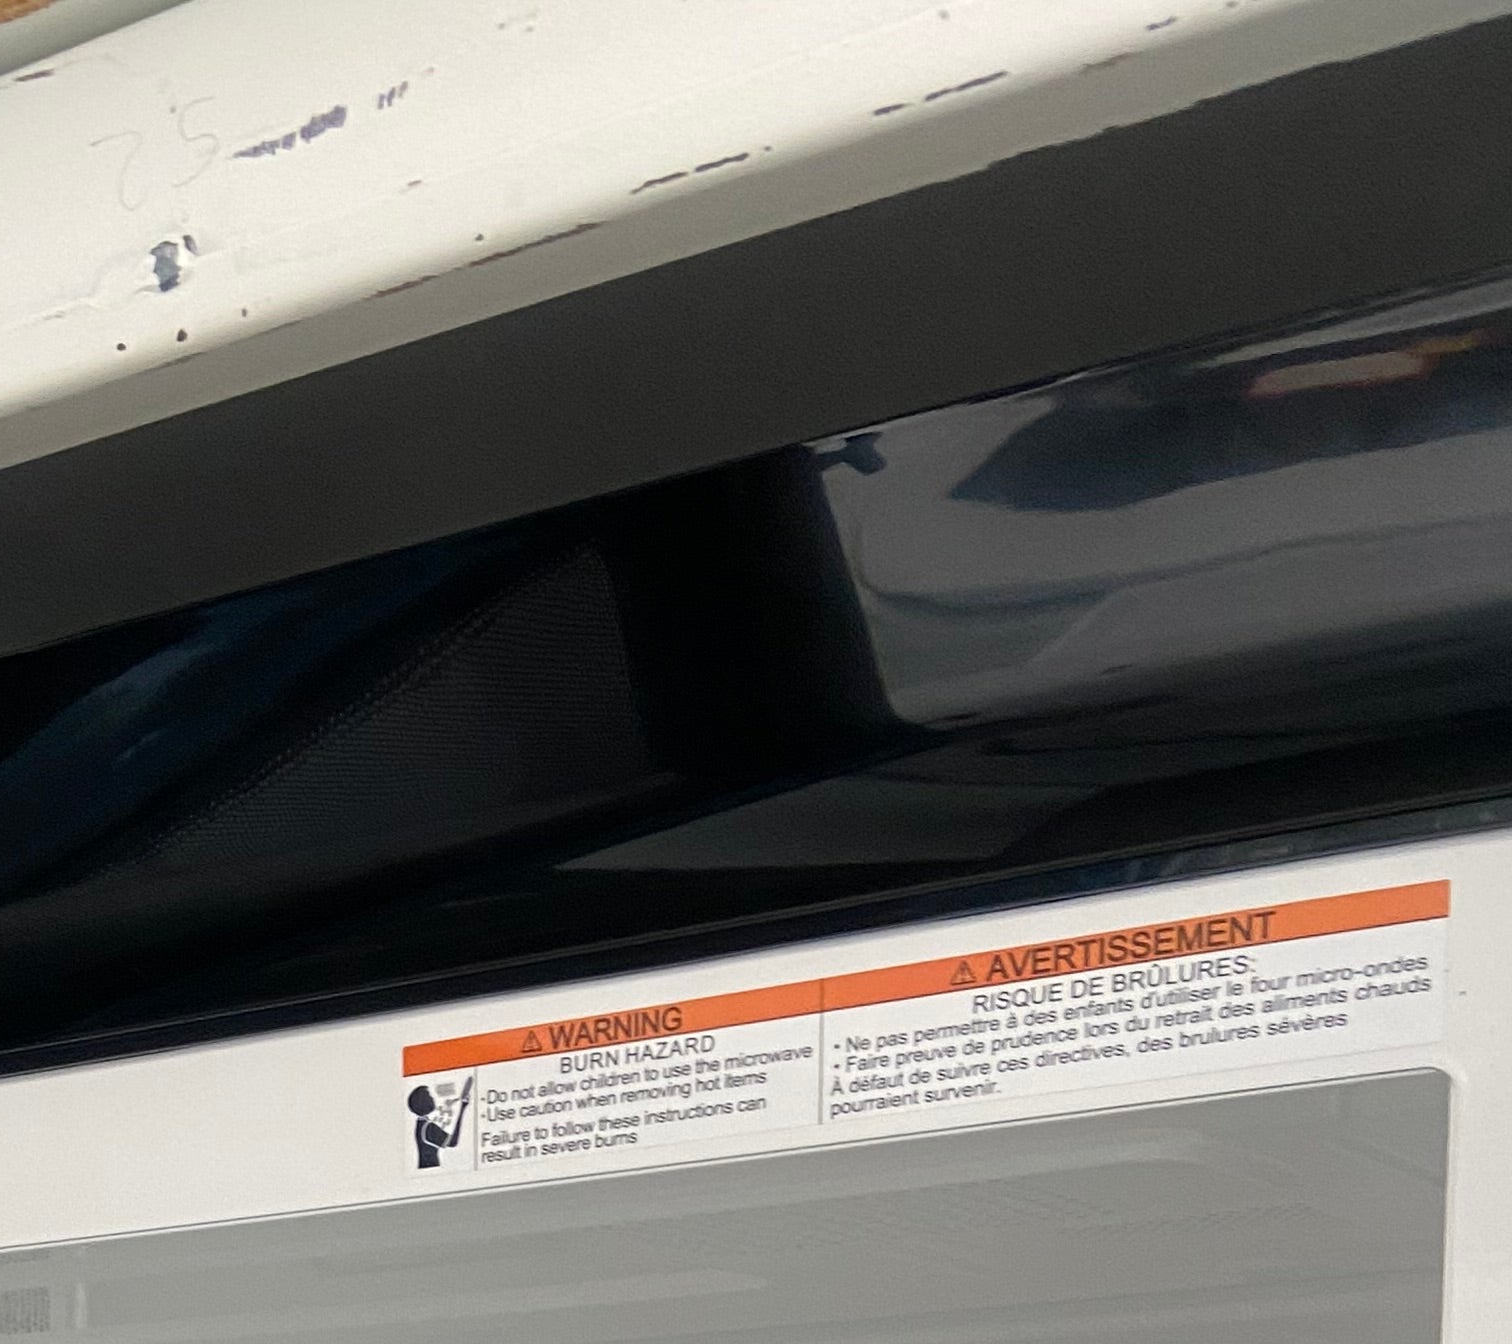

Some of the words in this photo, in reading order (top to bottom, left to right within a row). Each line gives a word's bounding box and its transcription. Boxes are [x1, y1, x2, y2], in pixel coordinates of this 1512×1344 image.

[987, 911, 1276, 981] AVERTISSEMENT
[845, 1036, 870, 1053] Ne
[875, 1032, 908, 1052] pas
[913, 1018, 1000, 1047] permettre
[1005, 1012, 1018, 1029] à
[1024, 1010, 1057, 1026] des
[1063, 999, 1134, 1021] enfants
[1226, 980, 1243, 996] le
[1250, 974, 1292, 993] four
[1296, 955, 1429, 987] micro-ondes
[972, 982, 1063, 1014] RISQUE
[1071, 976, 1104, 999] DE
[1112, 955, 1256, 993] BRÛLURES:
[549, 1007, 683, 1049] WARNING
[845, 1053, 889, 1072] Faire
[895, 1048, 958, 1068] preuve
[962, 1039, 985, 1056] de
[991, 1027, 1078, 1056] prudence
[1084, 1022, 1119, 1038] lors
[1125, 1015, 1150, 1033] du
[1155, 1005, 1213, 1029] retrait
[1218, 1000, 1255, 1019] des
[1262, 988, 1348, 1014] aliments
[1354, 975, 1432, 1001] chauds
[511, 1085, 535, 1101] not
[538, 1080, 577, 1097] allow
[580, 1070, 640, 1091] children
[644, 1068, 659, 1082] to
[662, 1063, 691, 1078] use
[695, 1058, 720, 1074] the
[724, 1046, 814, 1070] microwave
[560, 1051, 619, 1074] BURN
[625, 1035, 716, 1064] HAZARD
[849, 1071, 904, 1093] défaut
[908, 1069, 932, 1085] de
[937, 1061, 991, 1081] suivre
[996, 1056, 1029, 1073] ces
[1035, 1043, 1130, 1068] directives,
[1137, 1036, 1173, 1053] des
[519, 1099, 572, 1118] caution
[575, 1093, 617, 1110] when
[620, 1082, 691, 1102] removing
[695, 1077, 721, 1093] hot
[723, 1072, 767, 1088] items
[830, 1090, 919, 1119] pourraient
[924, 1080, 1002, 1104] survenir.
[481, 1130, 530, 1148] Failure
[534, 1127, 549, 1140] to
[552, 1121, 595, 1138] follow
[598, 1115, 640, 1131] these
[644, 1102, 734, 1125] instructions
[738, 1097, 767, 1112] can
[481, 1146, 521, 1163] result
[524, 1144, 537, 1158] in
[541, 1139, 591, 1156] severe
[595, 1132, 638, 1148] burns
